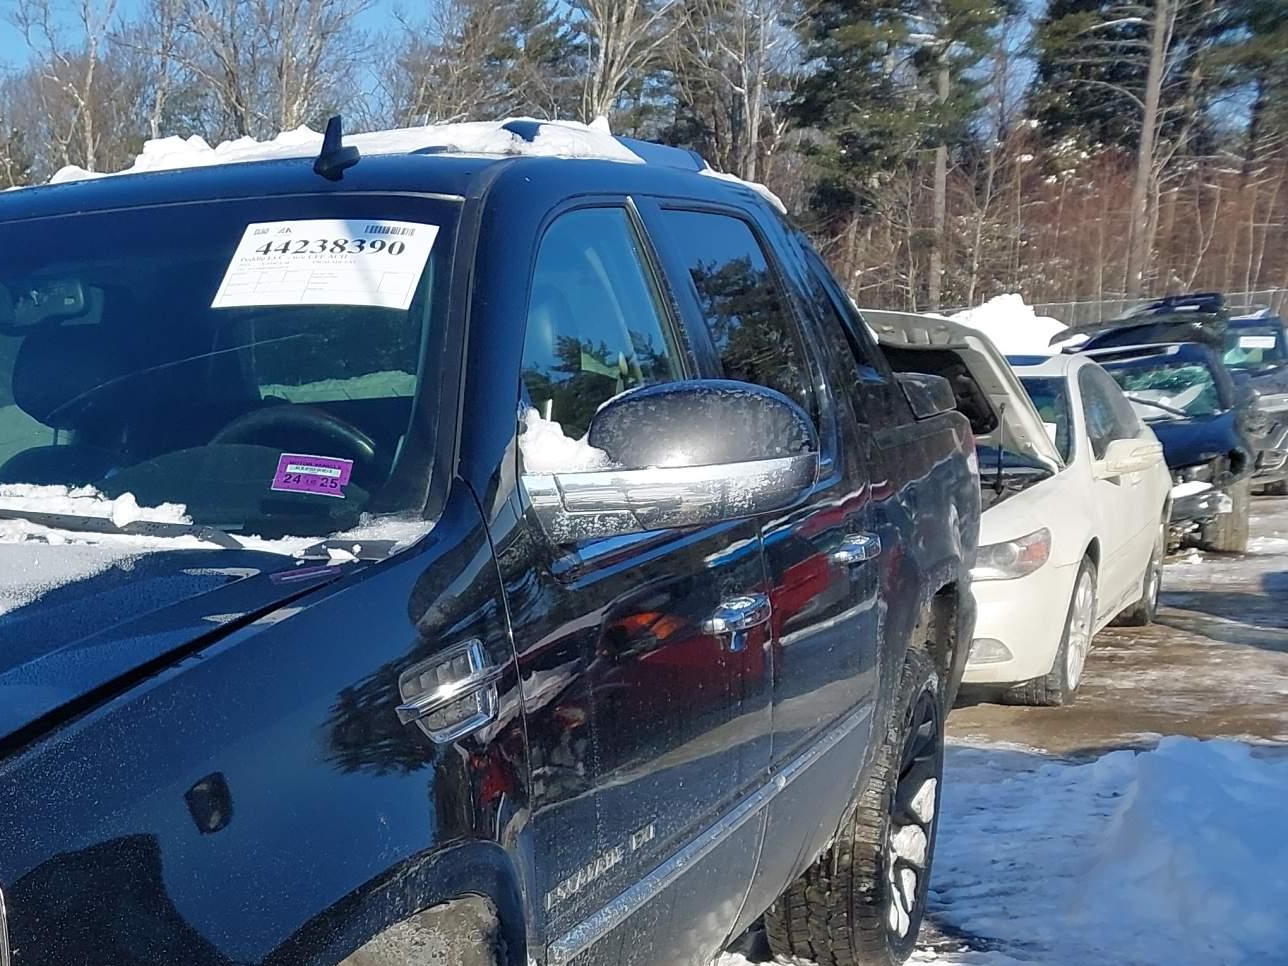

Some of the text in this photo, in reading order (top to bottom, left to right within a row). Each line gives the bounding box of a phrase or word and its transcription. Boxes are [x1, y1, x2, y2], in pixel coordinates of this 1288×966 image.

[255, 238, 406, 256] 44238390
[283, 474, 302, 484] 24
[319, 477, 338, 488] 25
